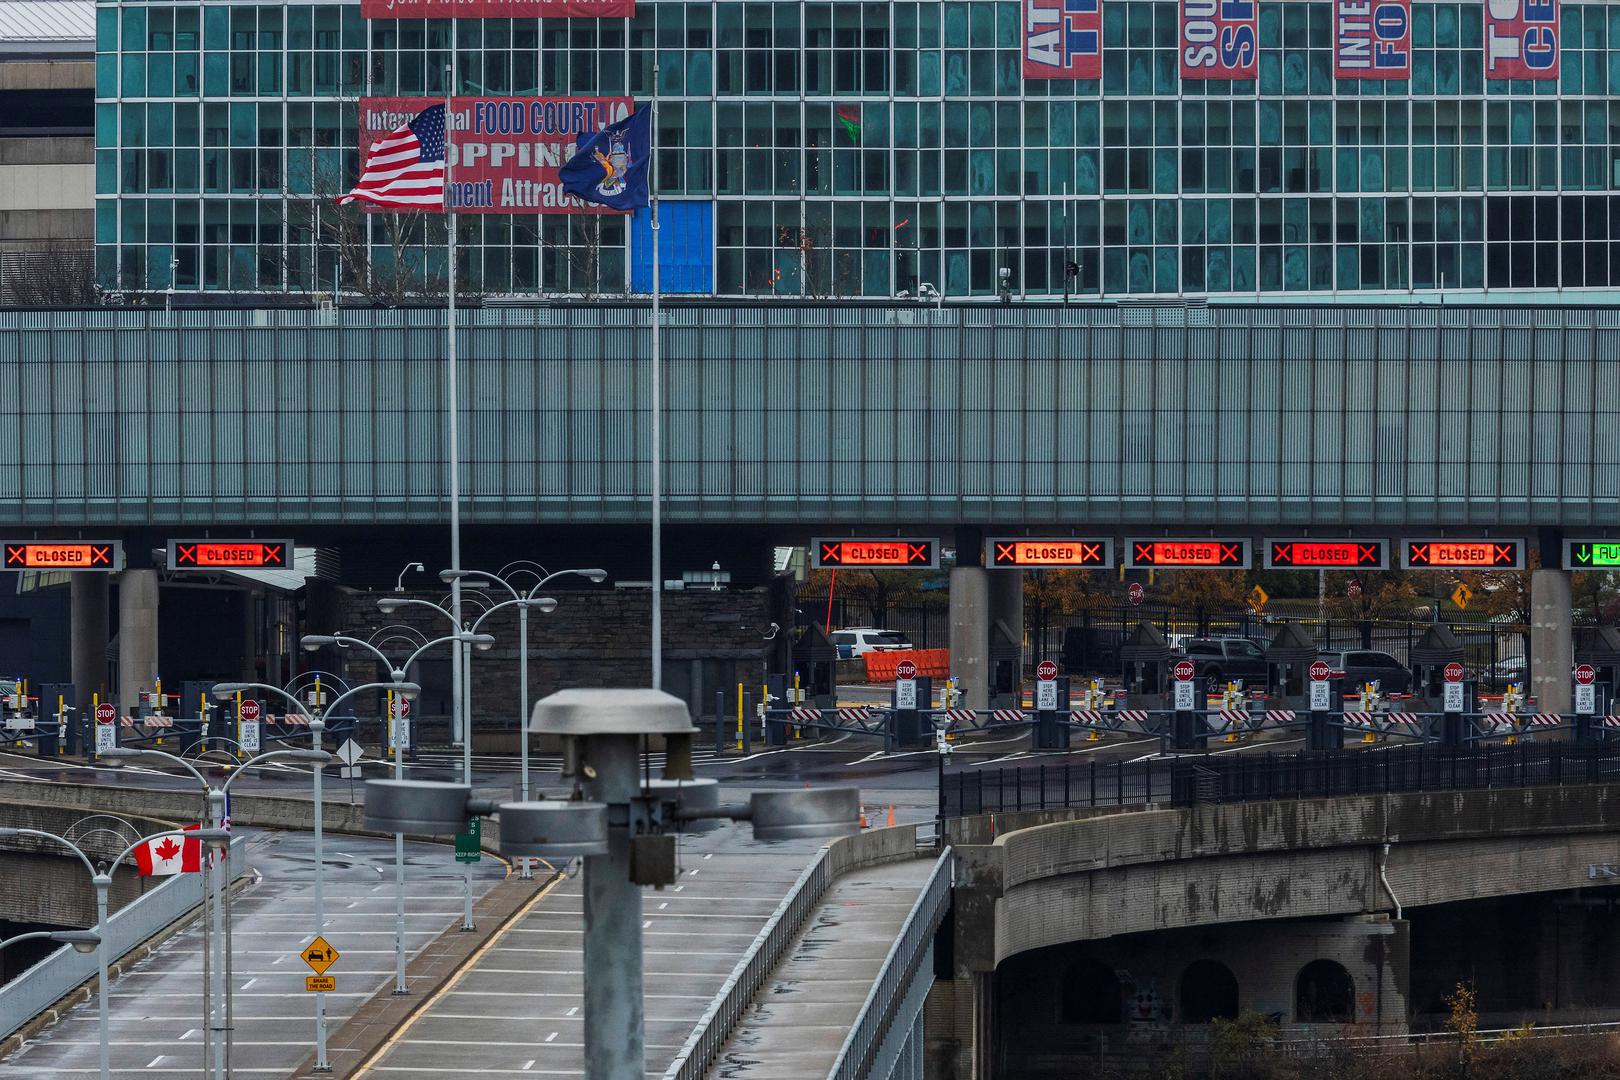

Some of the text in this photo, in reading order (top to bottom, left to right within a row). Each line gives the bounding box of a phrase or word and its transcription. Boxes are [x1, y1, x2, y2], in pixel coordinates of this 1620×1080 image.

[1064, 0, 1099, 69] T
[1184, 0, 1217, 67] SOU
[1339, 1, 1370, 67] INTE
[1374, 0, 1408, 69] FO
[475, 101, 526, 135] FOOD
[529, 101, 597, 135] COURT
[36, 550, 82, 562] CLOSED
[208, 550, 254, 561] CLOSED
[852, 548, 898, 559] CLOSED
[1026, 548, 1072, 559] CLOSED
[1164, 548, 1211, 560] CLOSED
[1303, 549, 1348, 560] CLOSED
[1440, 549, 1485, 560] CLOSED
[1600, 546, 1620, 560] AU
[1176, 667, 1192, 675] STOP
[1311, 667, 1328, 676] STOP
[241, 706, 258, 714] STOP
[391, 703, 408, 711] SOP
